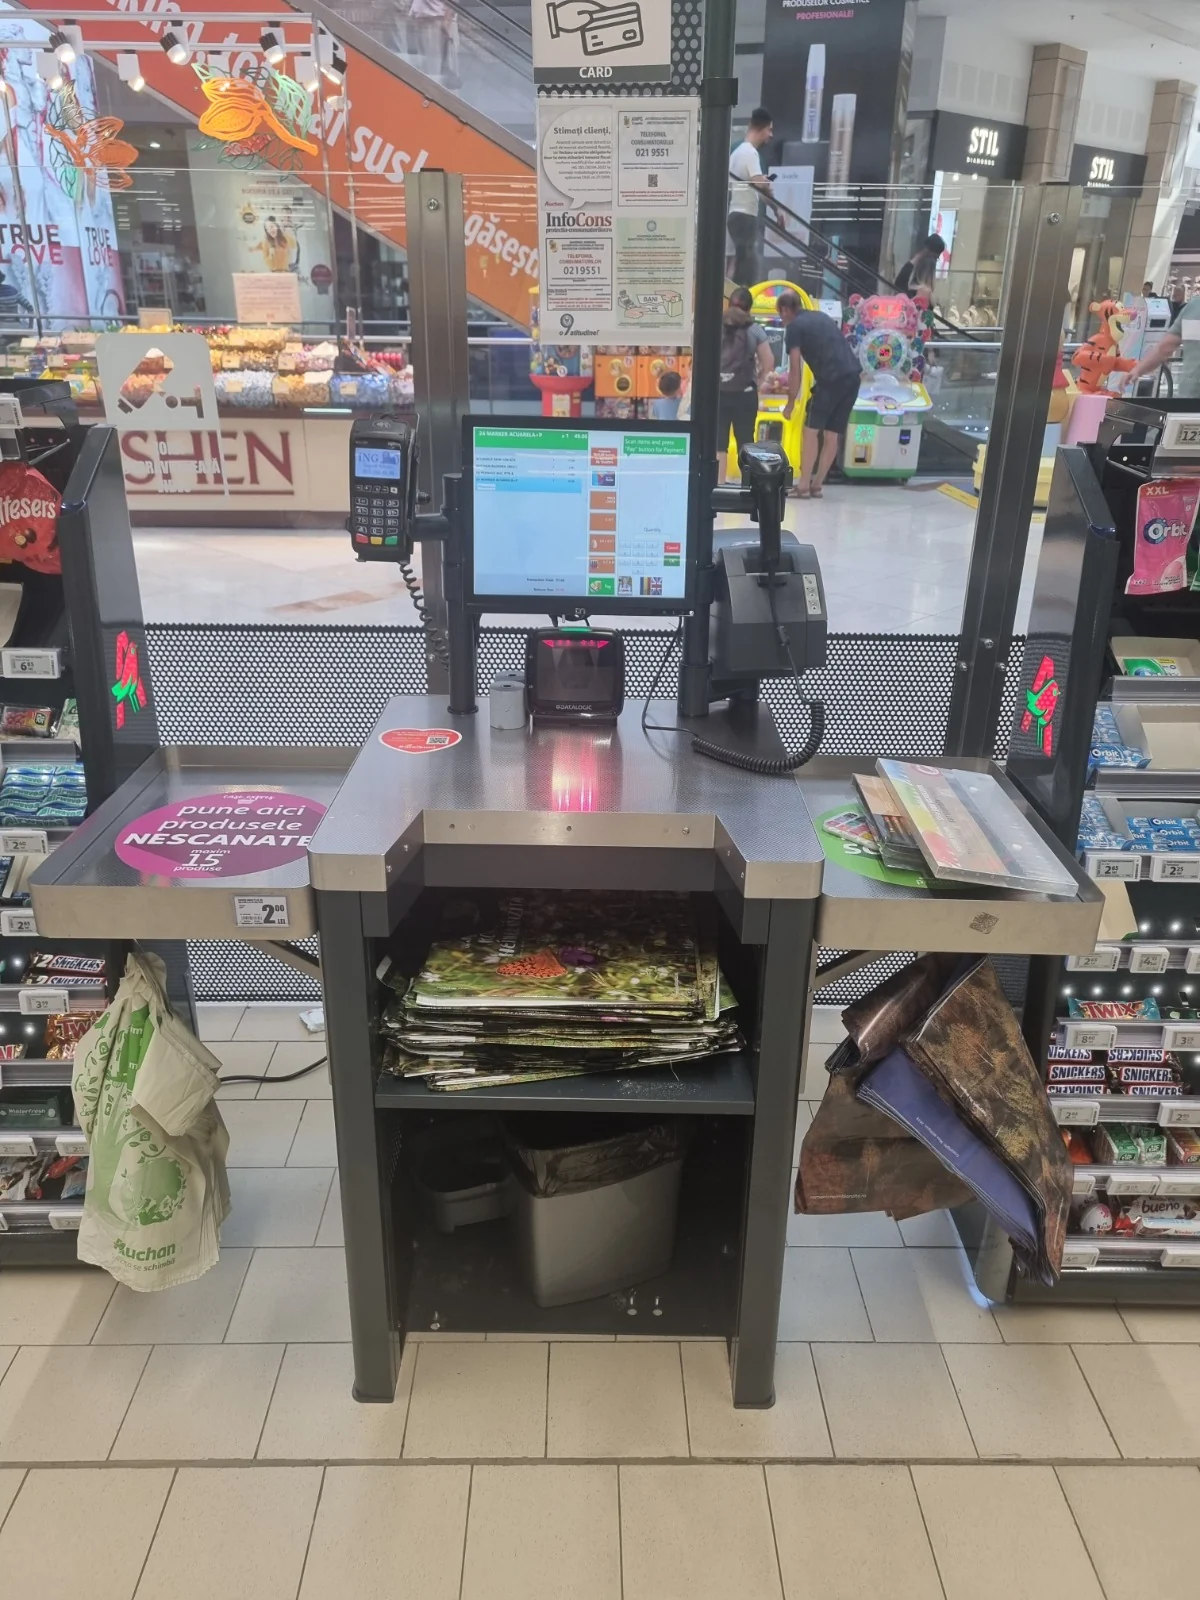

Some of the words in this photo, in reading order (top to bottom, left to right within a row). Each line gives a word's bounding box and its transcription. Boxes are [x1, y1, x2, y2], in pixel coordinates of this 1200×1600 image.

[796, 10, 854, 20] PROFESIONALE!
[579, 67, 612, 78] CARD
[969, 127, 999, 156] STIL
[635, 148, 649, 156] 021
[651, 148, 669, 156] 9551
[966, 156, 995, 166] DIAMONDS
[1089, 155, 1114, 181] STIL
[545, 211, 612, 227] InfoCons
[0, 223, 59, 245] TRUE
[84, 226, 112, 248] TRUE
[88, 246, 114, 267] LOVE
[563, 266, 601, 275] 0219551
[358, 452, 379, 463] ING
[1146, 486, 1170, 496] XXL
[1147, 522, 1187, 540] Orbit
[1092, 749, 1119, 757] Orbit
[176, 805, 249, 817] pune
[256, 804, 306, 816] aici
[158, 818, 303, 831] produsele
[123, 832, 312, 847] NESCANATE
[182, 854, 225, 867] 15
[52, 956, 102, 971] SNICKERS
[1080, 1001, 1138, 1018] TWIX
[1109, 1049, 1163, 1061] SNICKERS
[1051, 1066, 1105, 1079] SNICKERS
[1141, 1199, 1180, 1214] bueno
[113, 1237, 176, 1261] Auchan
